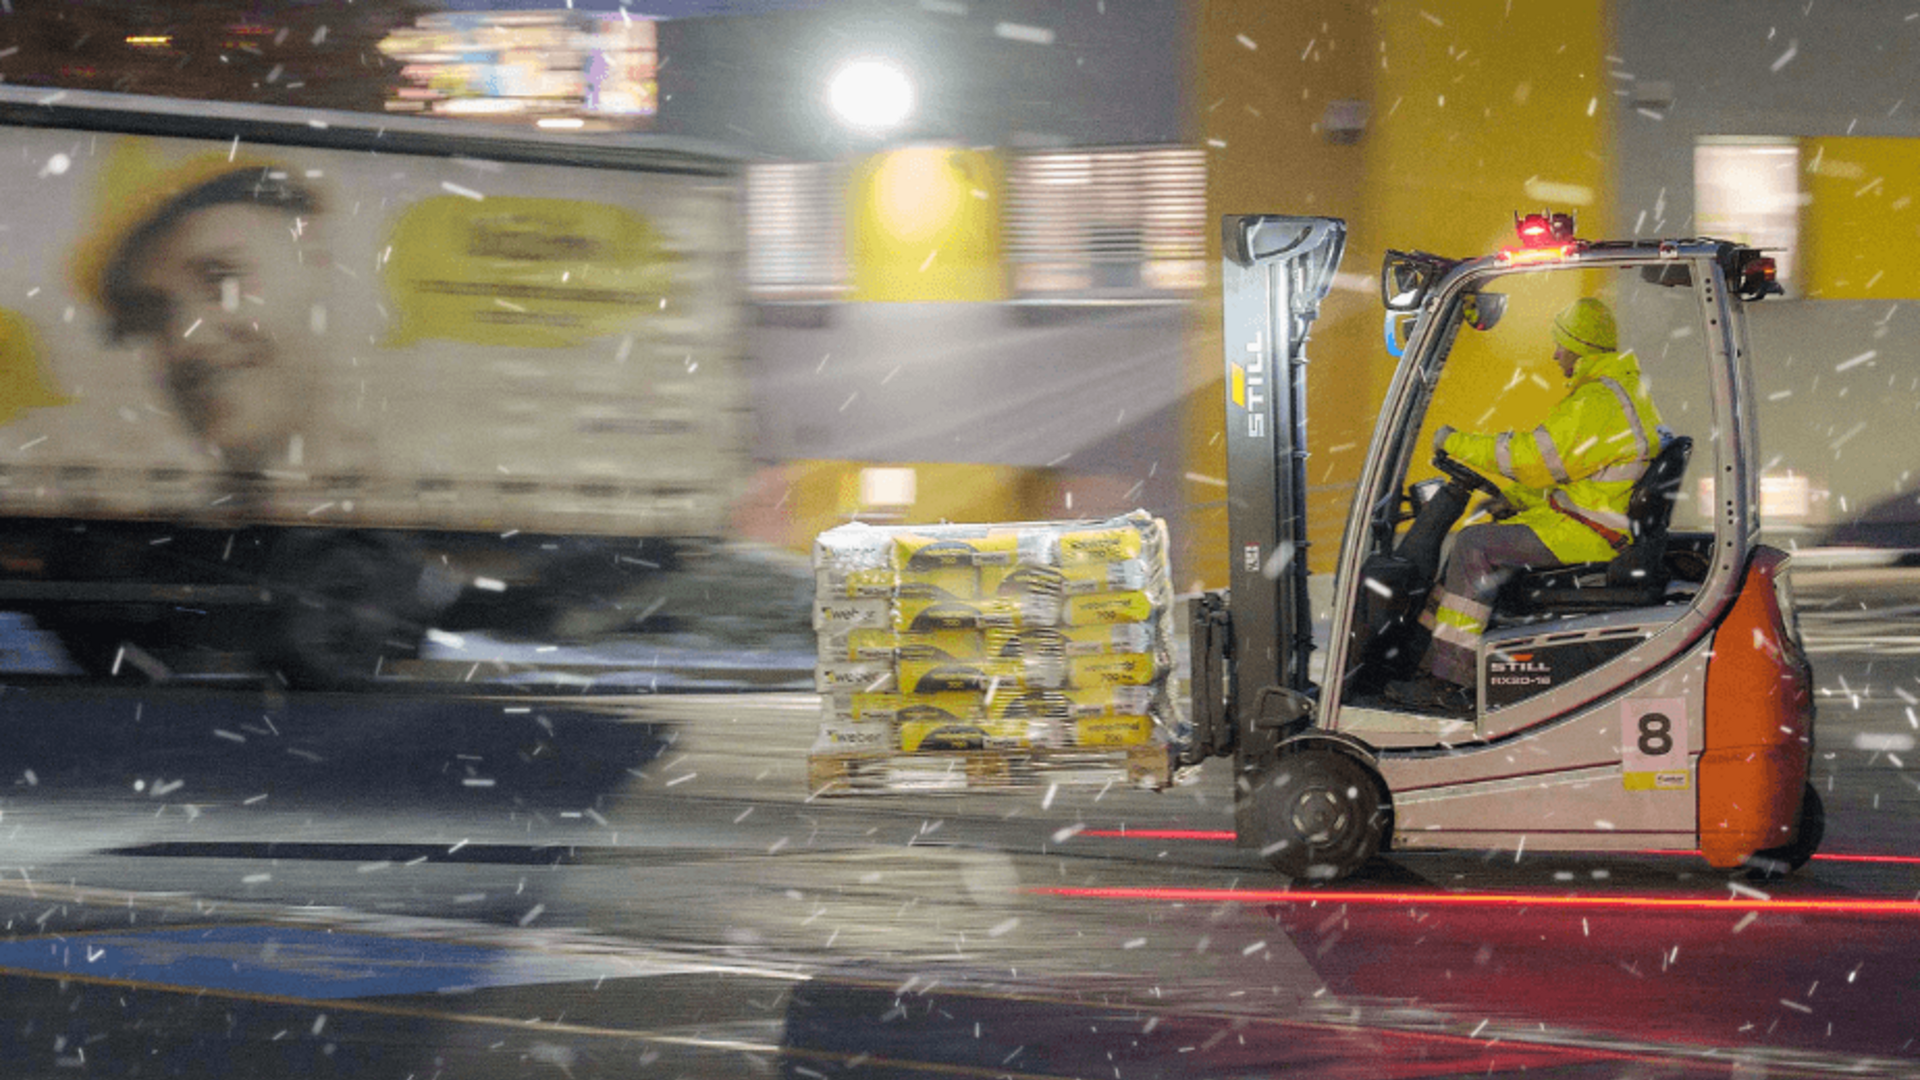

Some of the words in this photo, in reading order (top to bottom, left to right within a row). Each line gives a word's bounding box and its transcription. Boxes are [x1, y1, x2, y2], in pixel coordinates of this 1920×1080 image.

[1247, 331, 1264, 437] STILL
[1491, 662, 1551, 672] STILL
[836, 732, 883, 743] weber
[1637, 712, 1674, 756] 8
